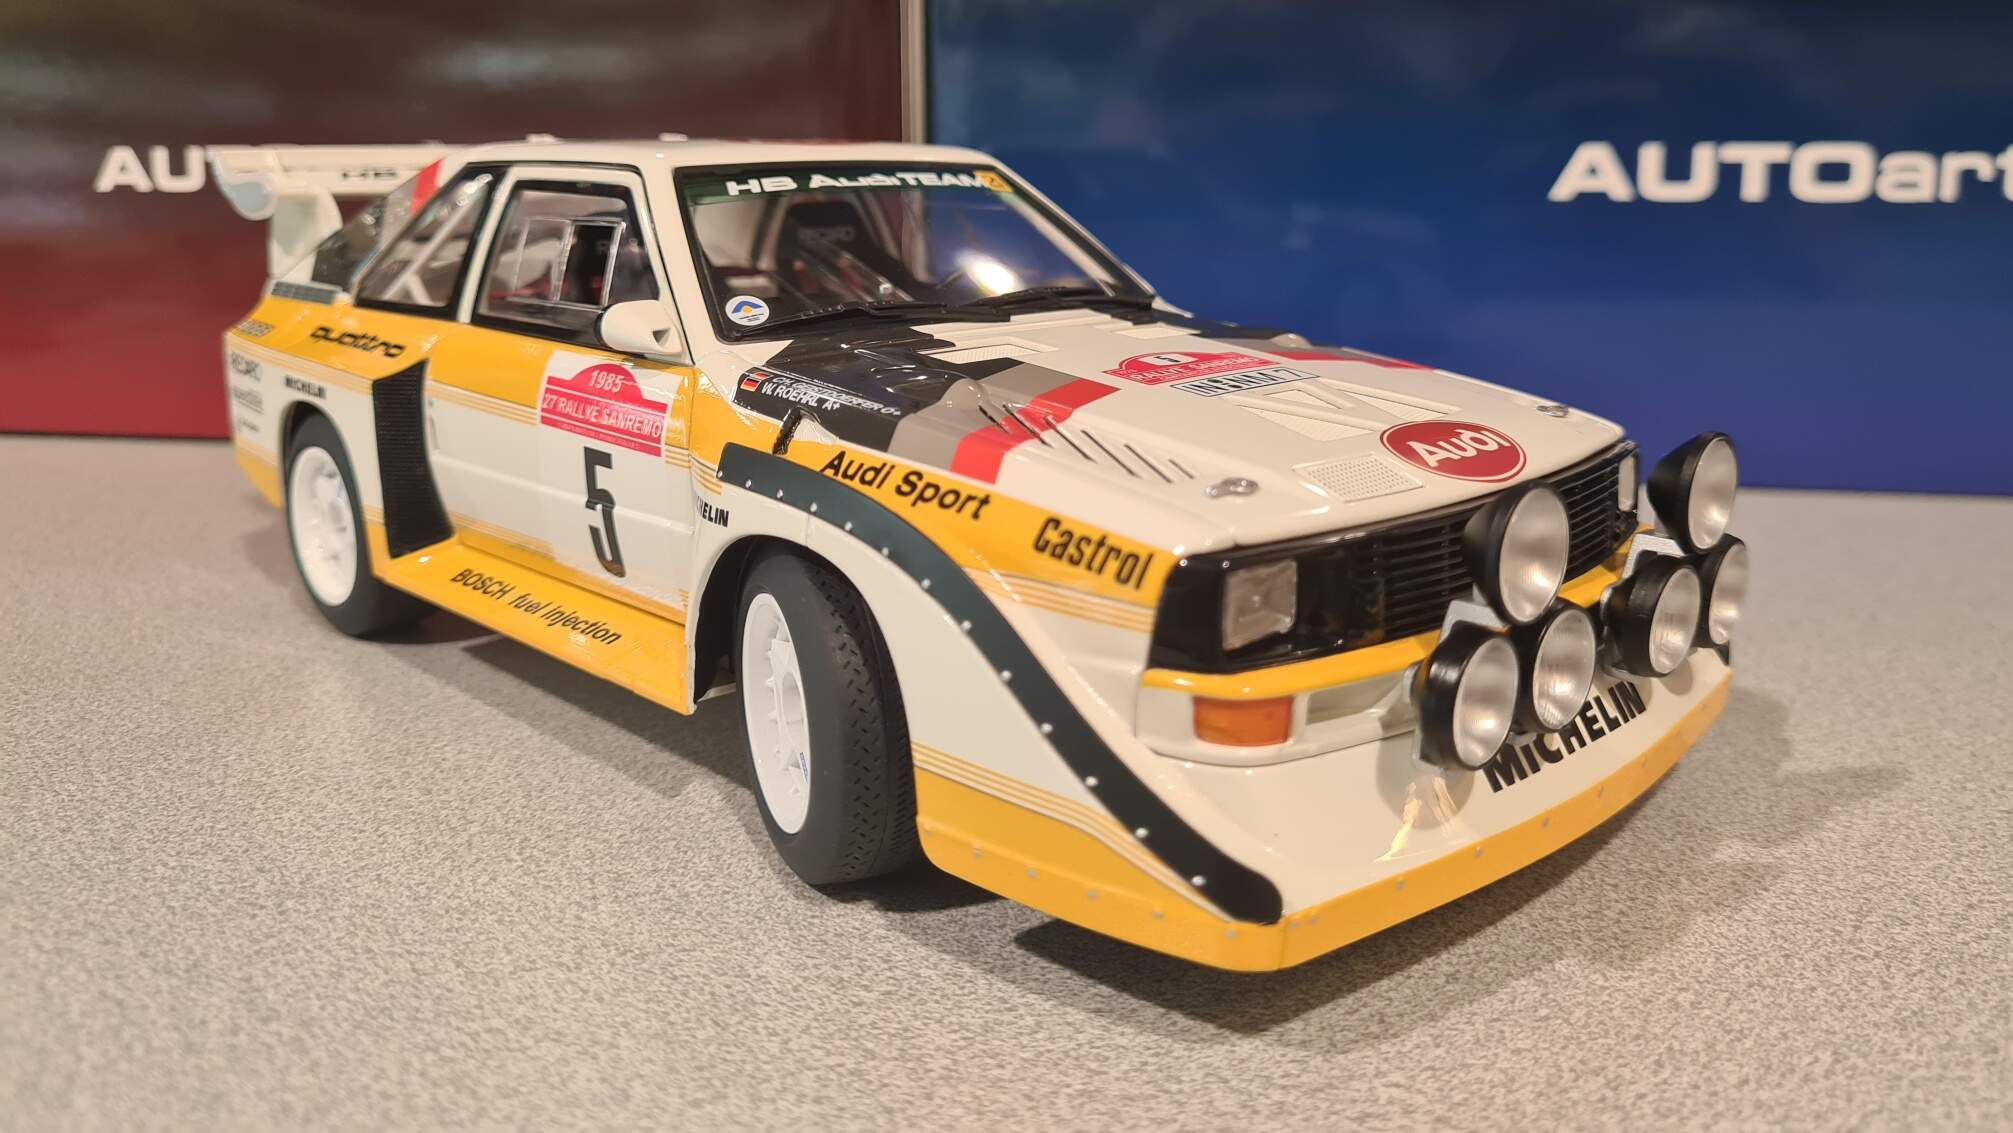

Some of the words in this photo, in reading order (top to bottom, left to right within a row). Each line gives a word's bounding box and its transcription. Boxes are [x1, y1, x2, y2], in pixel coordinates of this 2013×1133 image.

[93, 144, 213, 193] AU
[726, 176, 798, 196] HB
[309, 325, 406, 359] quattro
[589, 370, 624, 393] 1985
[774, 384, 818, 408] ROEHRL
[557, 397, 600, 423] RALLYE
[601, 408, 662, 438] SANREMO
[1406, 428, 1511, 468] Audi
[820, 450, 895, 490] Audi
[895, 470, 992, 520] Sport
[584, 446, 626, 578] 5
[1032, 517, 1154, 592] Castrol
[450, 568, 514, 600] BOSCH
[508, 593, 551, 615] fuel
[540, 605, 623, 645] injection
[1482, 681, 1647, 794] MICHELIN
